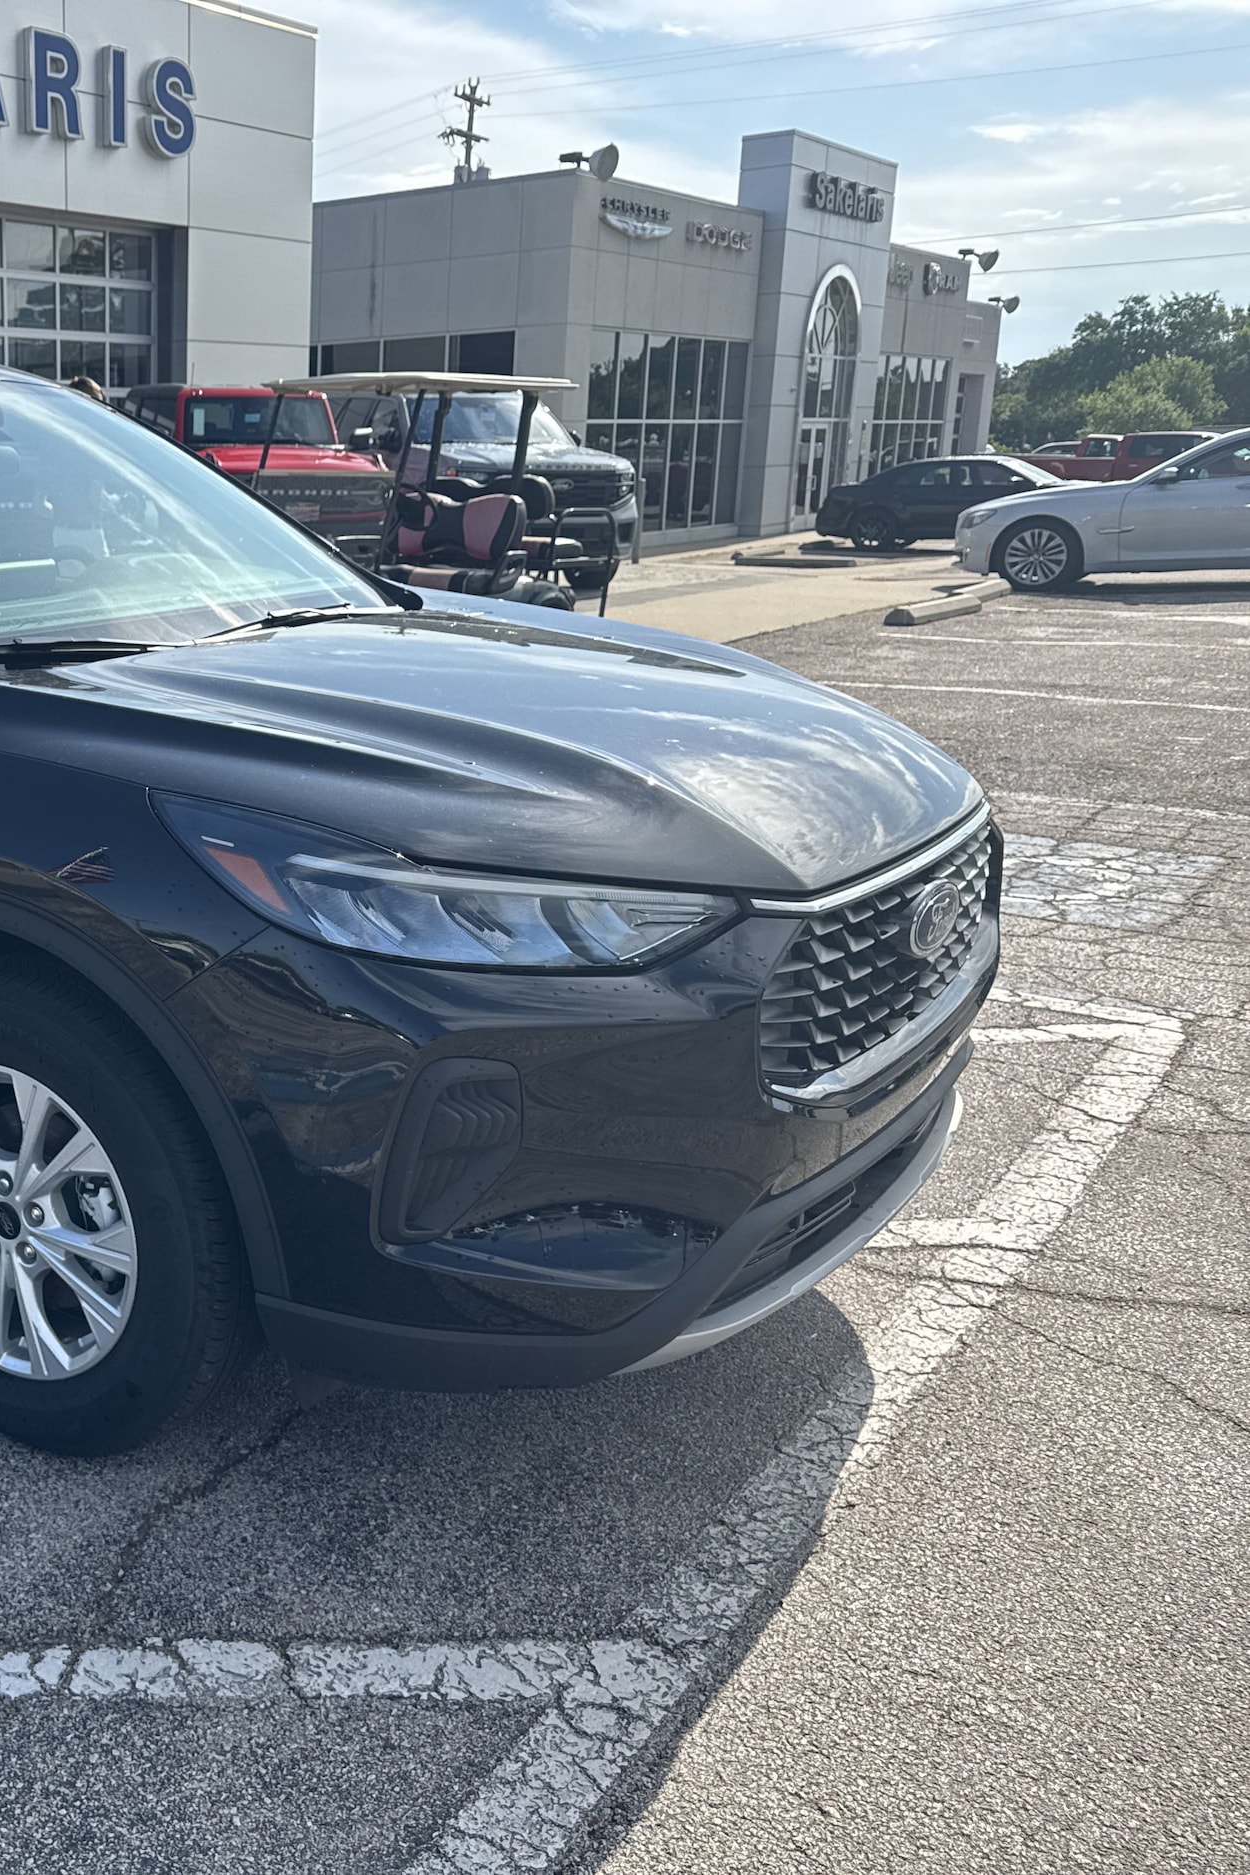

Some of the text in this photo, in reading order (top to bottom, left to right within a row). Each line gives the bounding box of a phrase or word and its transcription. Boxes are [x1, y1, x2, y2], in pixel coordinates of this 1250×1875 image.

[602, 197, 671, 220] CHRYSLER
[813, 171, 885, 223] Sakelaris
[690, 221, 752, 251] DODGE
[256, 487, 349, 497] BRONCO
